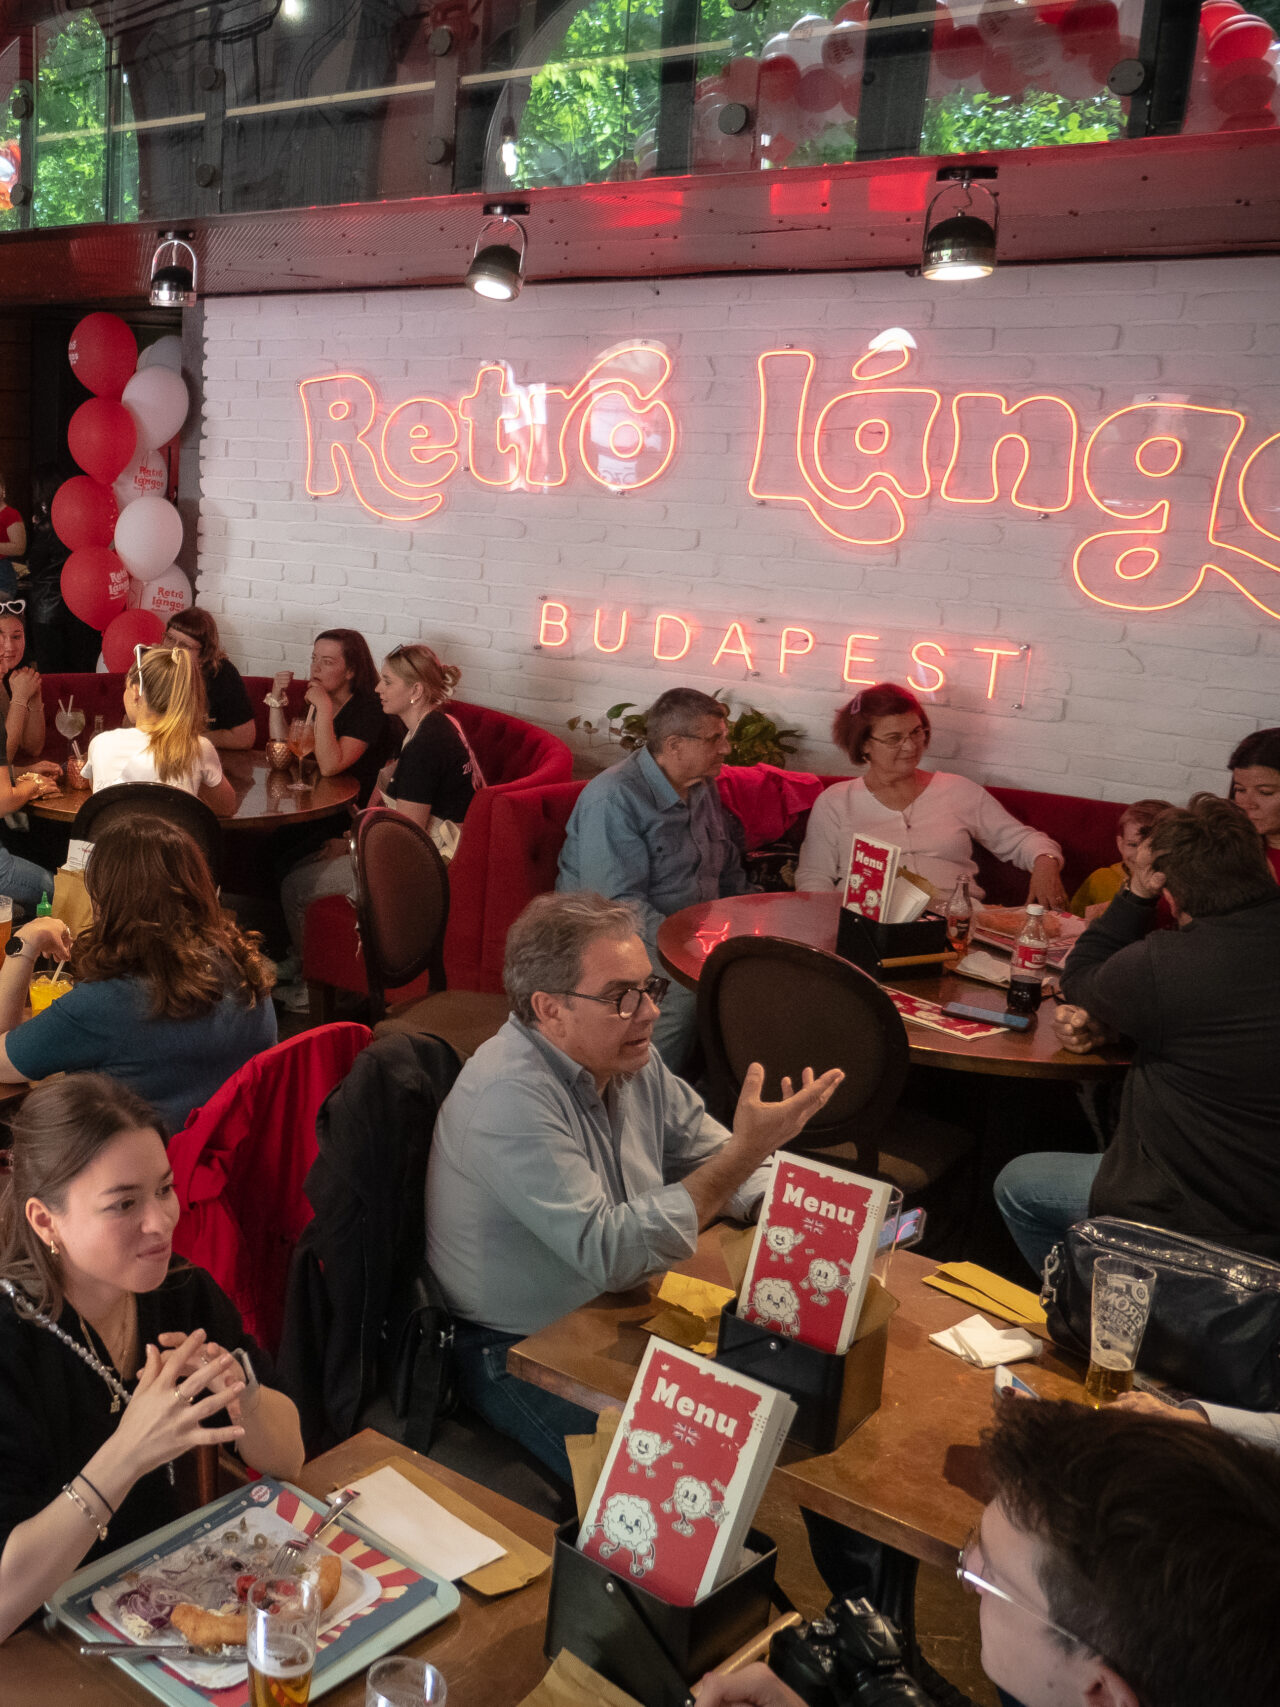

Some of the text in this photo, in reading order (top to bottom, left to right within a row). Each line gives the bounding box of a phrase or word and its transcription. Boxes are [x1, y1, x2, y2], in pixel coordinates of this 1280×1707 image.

[298, 338, 677, 521] Retró
[540, 601, 1022, 701] BUDAPEST
[855, 850, 884, 871] Menu
[781, 1182, 856, 1226] Menu
[650, 1376, 738, 1439] Menu
